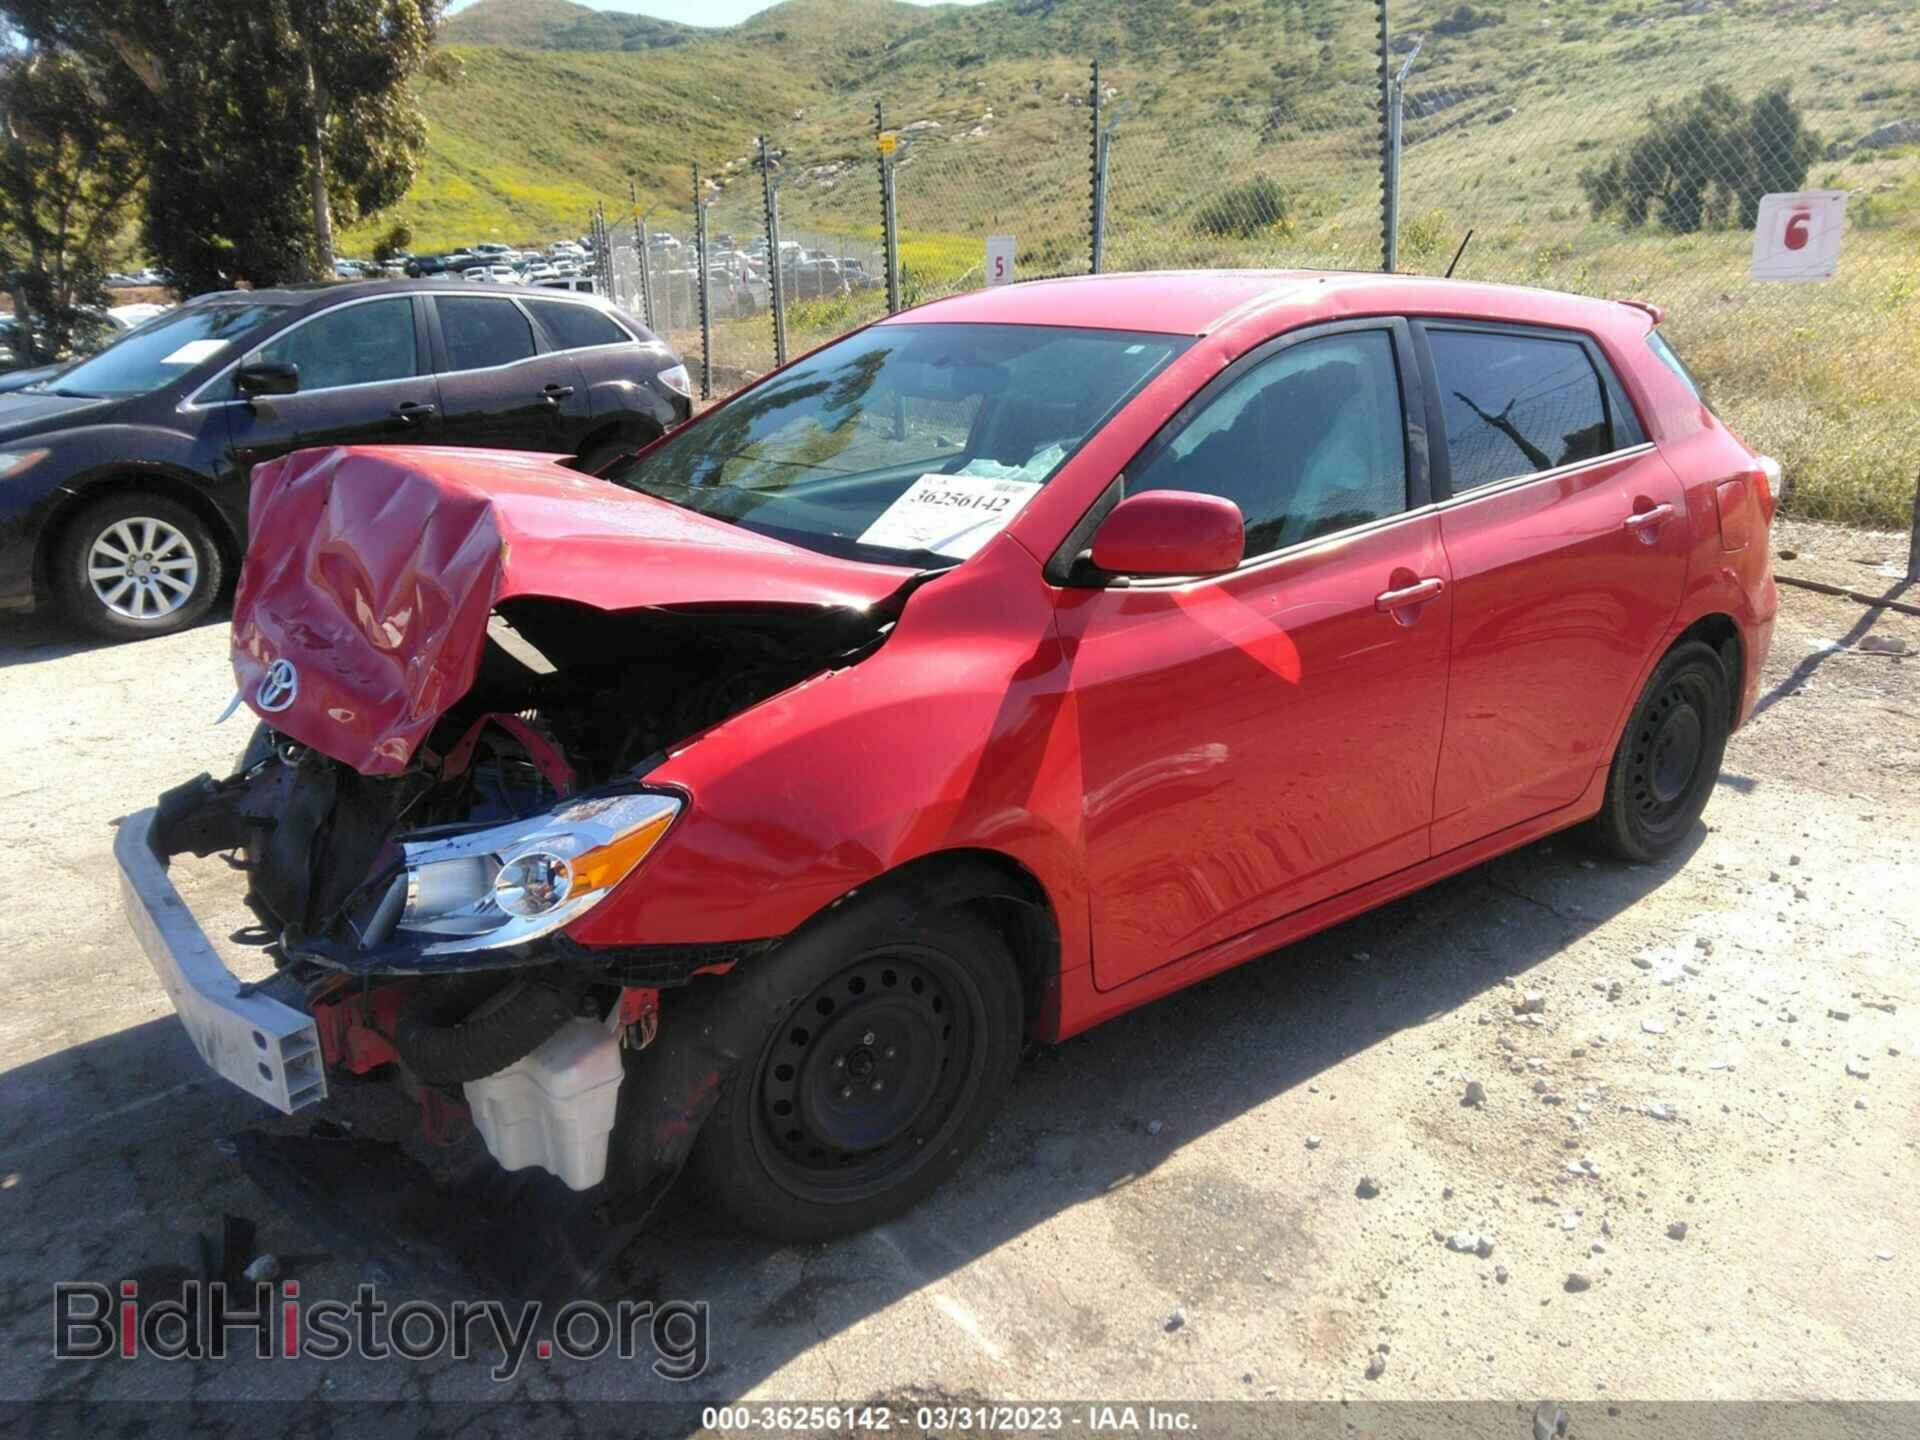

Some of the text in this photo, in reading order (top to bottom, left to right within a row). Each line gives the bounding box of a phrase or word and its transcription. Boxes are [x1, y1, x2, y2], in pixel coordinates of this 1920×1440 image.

[1784, 212, 1811, 251] 6
[994, 256, 1004, 277] 5
[910, 489, 1011, 512] 36256142
